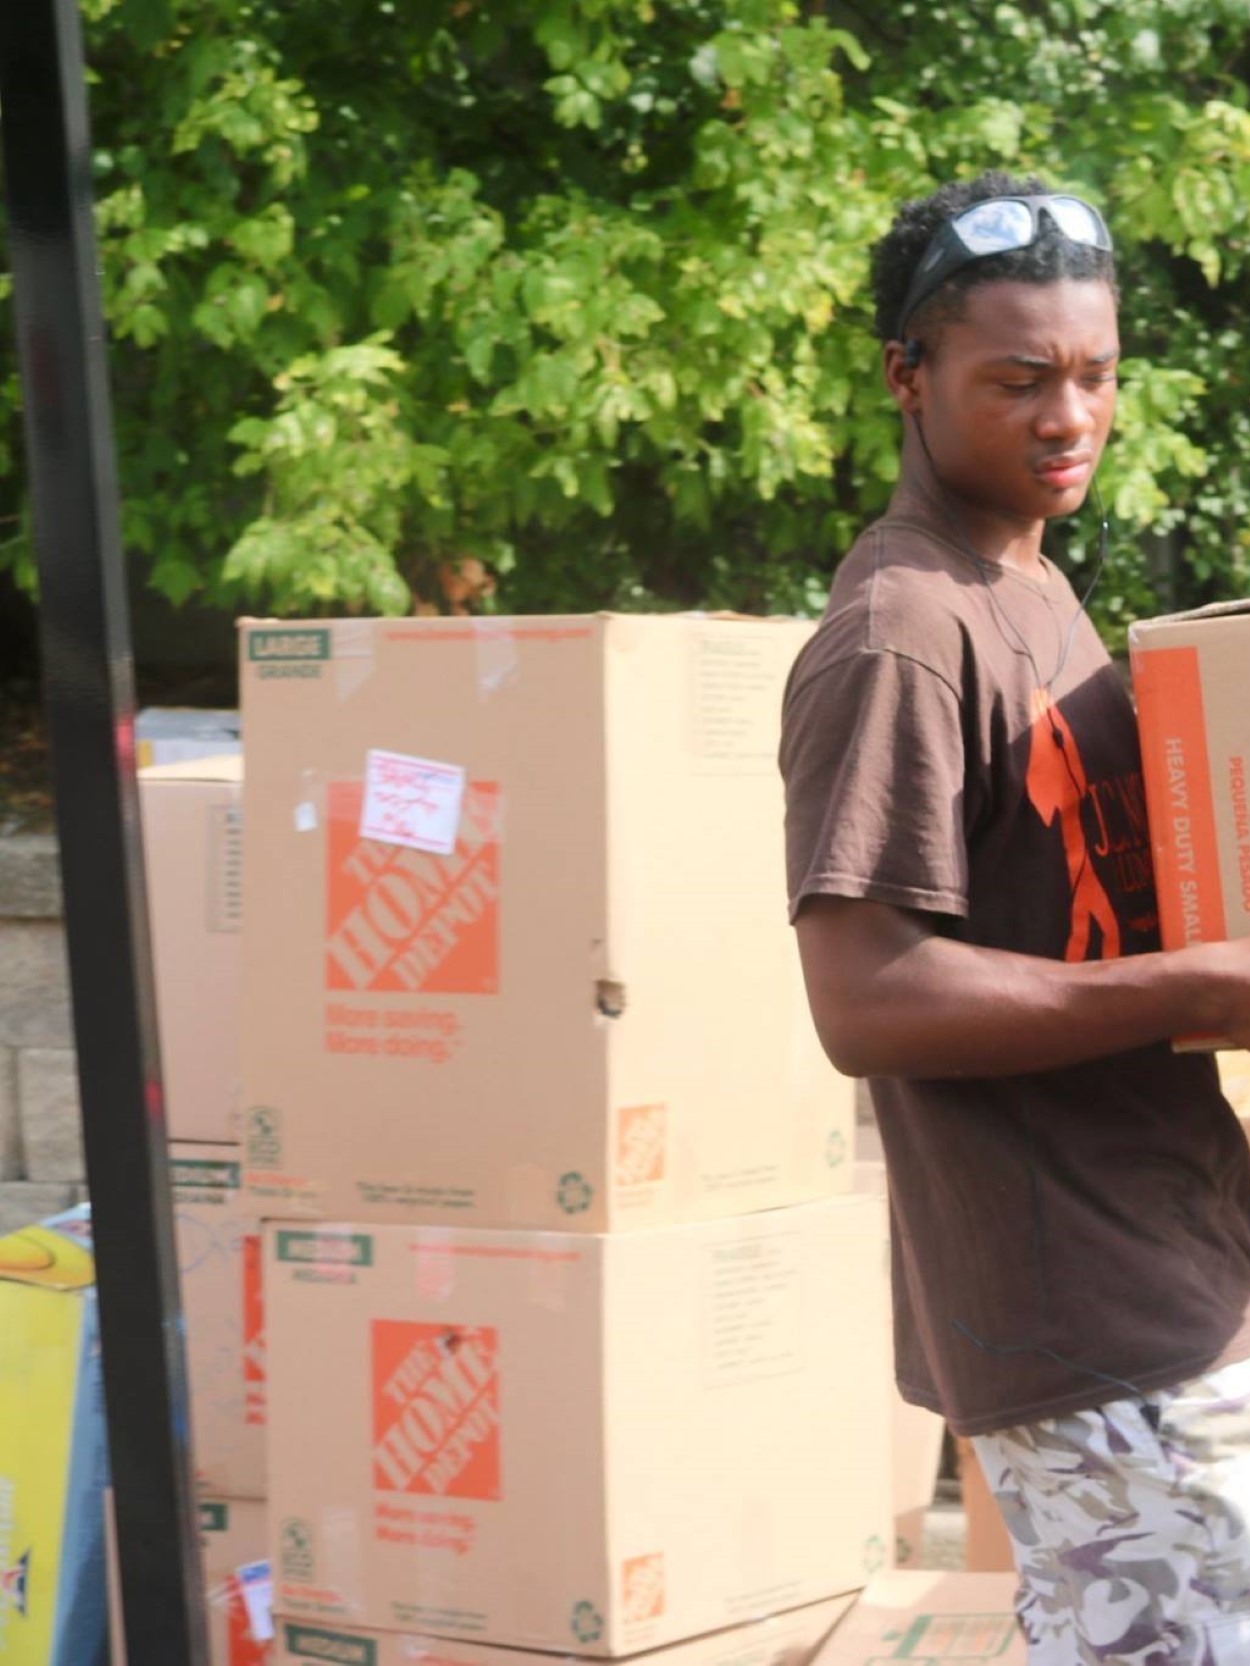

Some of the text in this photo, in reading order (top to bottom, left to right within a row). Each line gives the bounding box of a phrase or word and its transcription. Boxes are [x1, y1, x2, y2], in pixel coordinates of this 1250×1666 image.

[1165, 737, 1188, 809] HEAVY
[1173, 815, 1196, 873] DUTY
[375, 1330, 500, 1492] HOME
